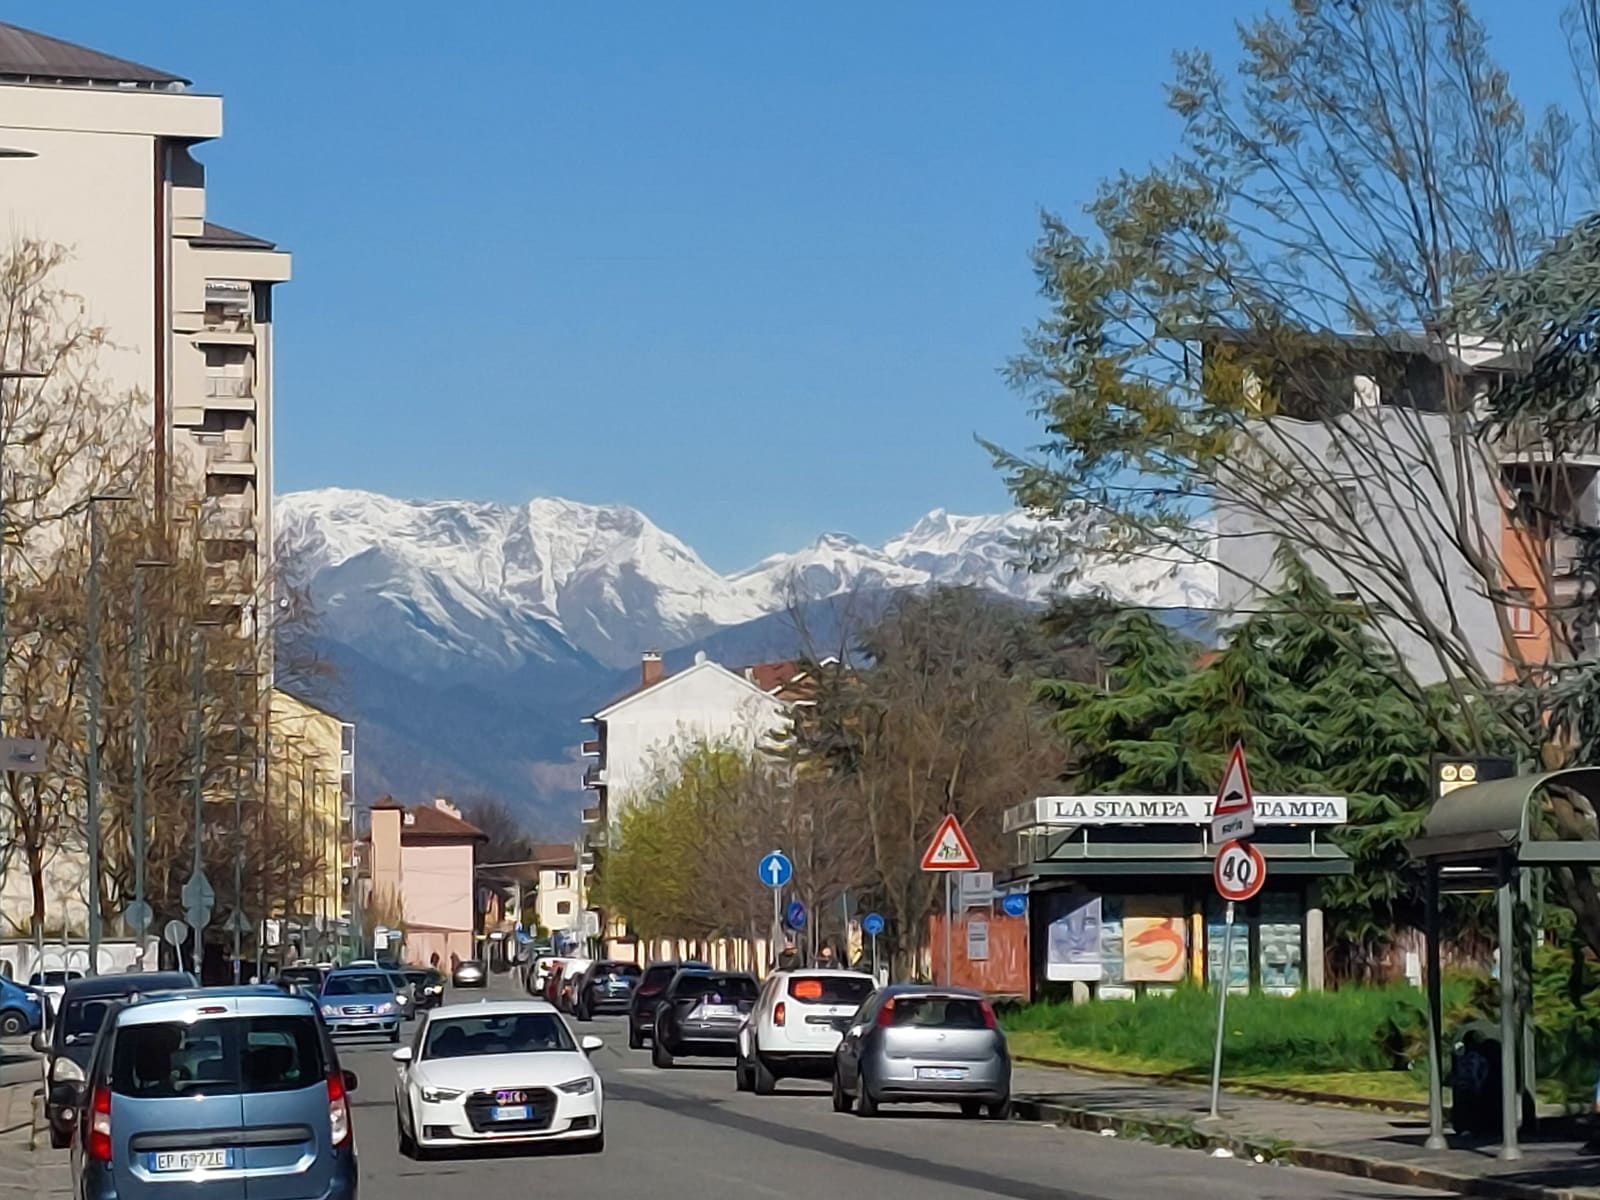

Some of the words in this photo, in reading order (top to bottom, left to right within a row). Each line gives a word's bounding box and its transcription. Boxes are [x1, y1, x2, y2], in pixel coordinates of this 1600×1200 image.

[1055, 801, 1087, 817] LA
[1093, 801, 1190, 817] STAMPA
[1255, 802, 1339, 817] TAMPA
[1223, 856, 1251, 884] 40
